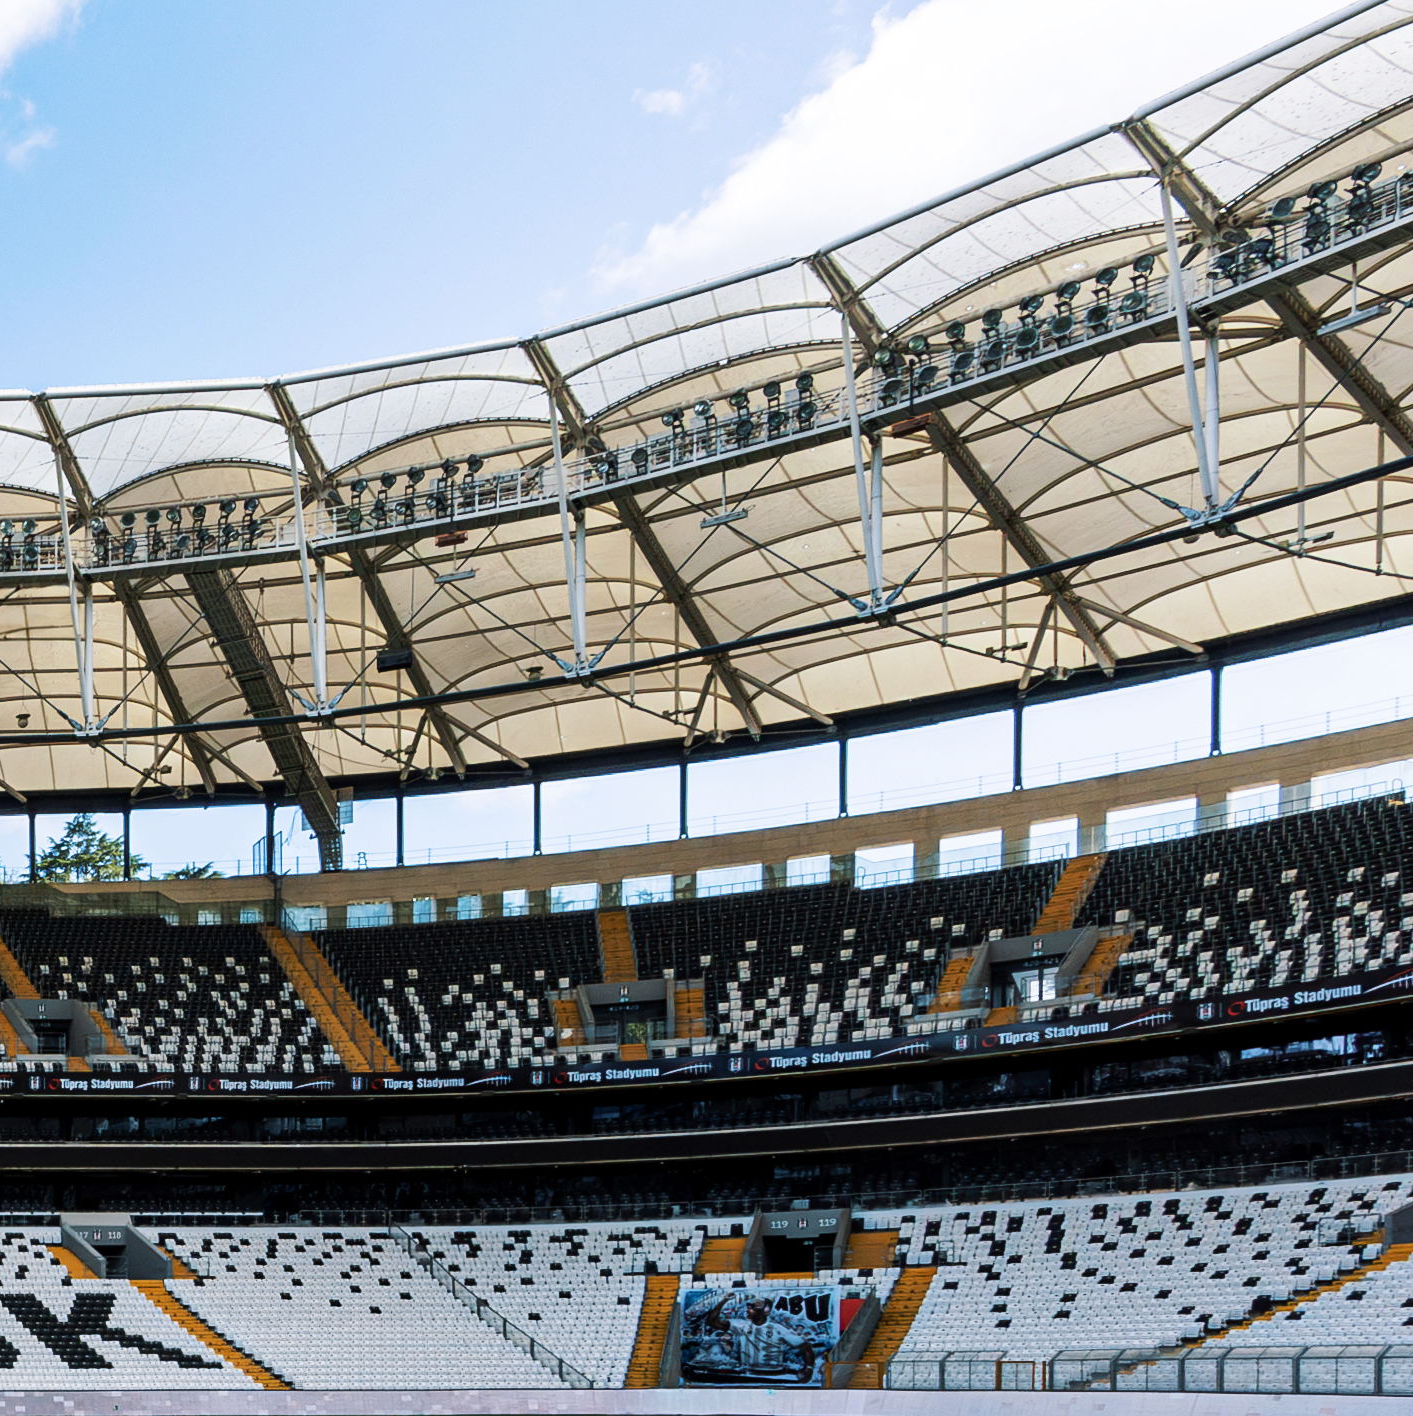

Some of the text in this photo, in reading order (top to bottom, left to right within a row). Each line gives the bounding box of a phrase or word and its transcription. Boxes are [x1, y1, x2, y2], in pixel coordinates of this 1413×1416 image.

[1245, 983, 1362, 1015] Tüpraş Stadyumu
[998, 1020, 1109, 1046] Tüpraş Stadyumu
[769, 1048, 871, 1069] Tüpraş Stadyumu
[383, 1077, 464, 1090] Tüpraş Stadyumu
[567, 1066, 660, 1084] Tüpraş Stadyumu
[60, 1078, 133, 1091] Tüpraş Stadyumu
[219, 1079, 292, 1091] Tüpraş Stadyumu
[771, 1218, 837, 1229] 119 119
[774, 1292, 833, 1325] ABU
